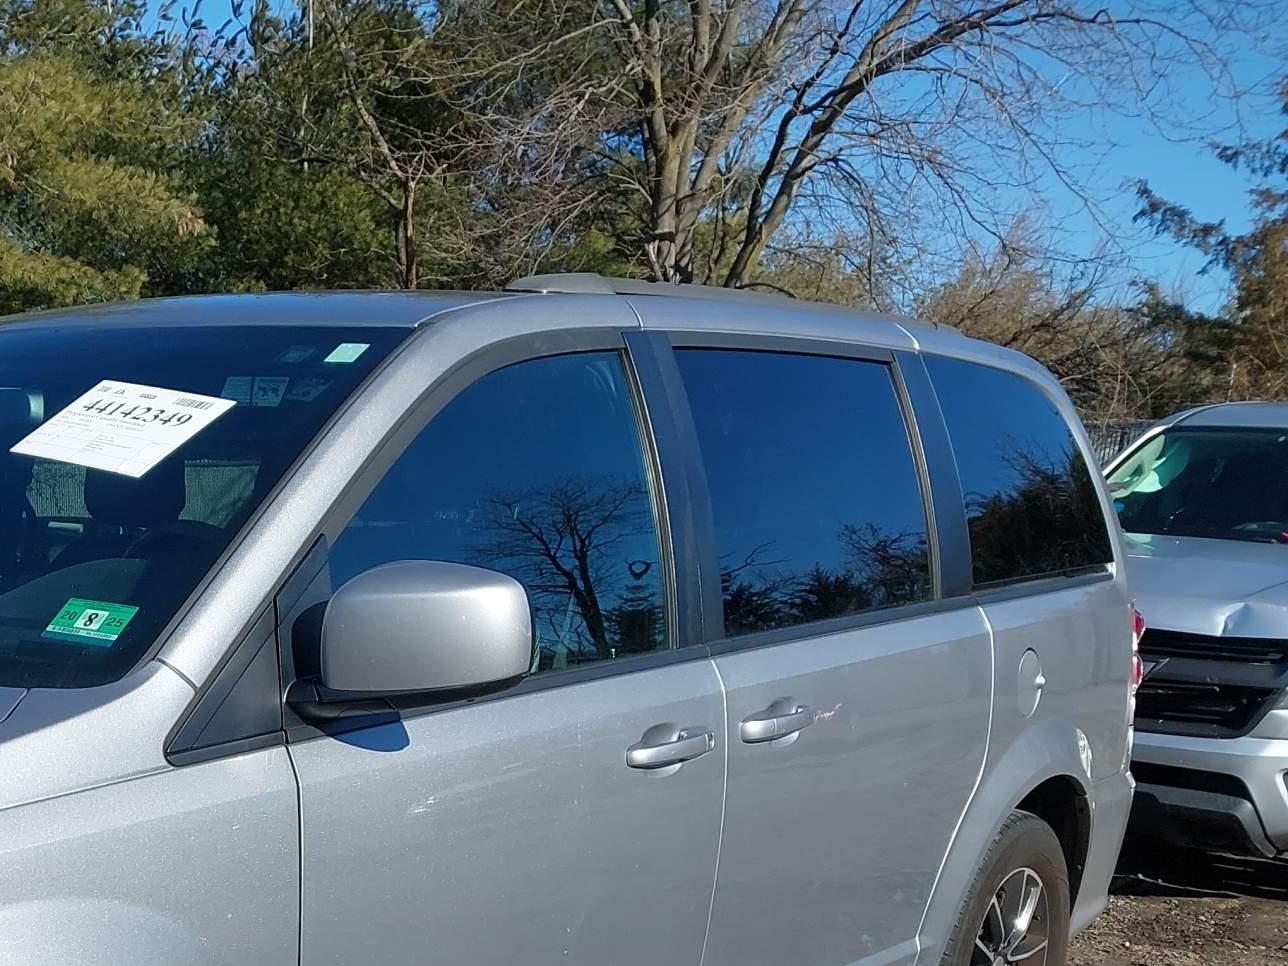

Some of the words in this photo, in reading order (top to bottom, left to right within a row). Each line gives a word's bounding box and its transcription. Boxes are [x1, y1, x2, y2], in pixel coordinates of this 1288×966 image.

[82, 399, 193, 427] 44142349
[60, 610, 78, 621] 20
[83, 612, 99, 627] 8
